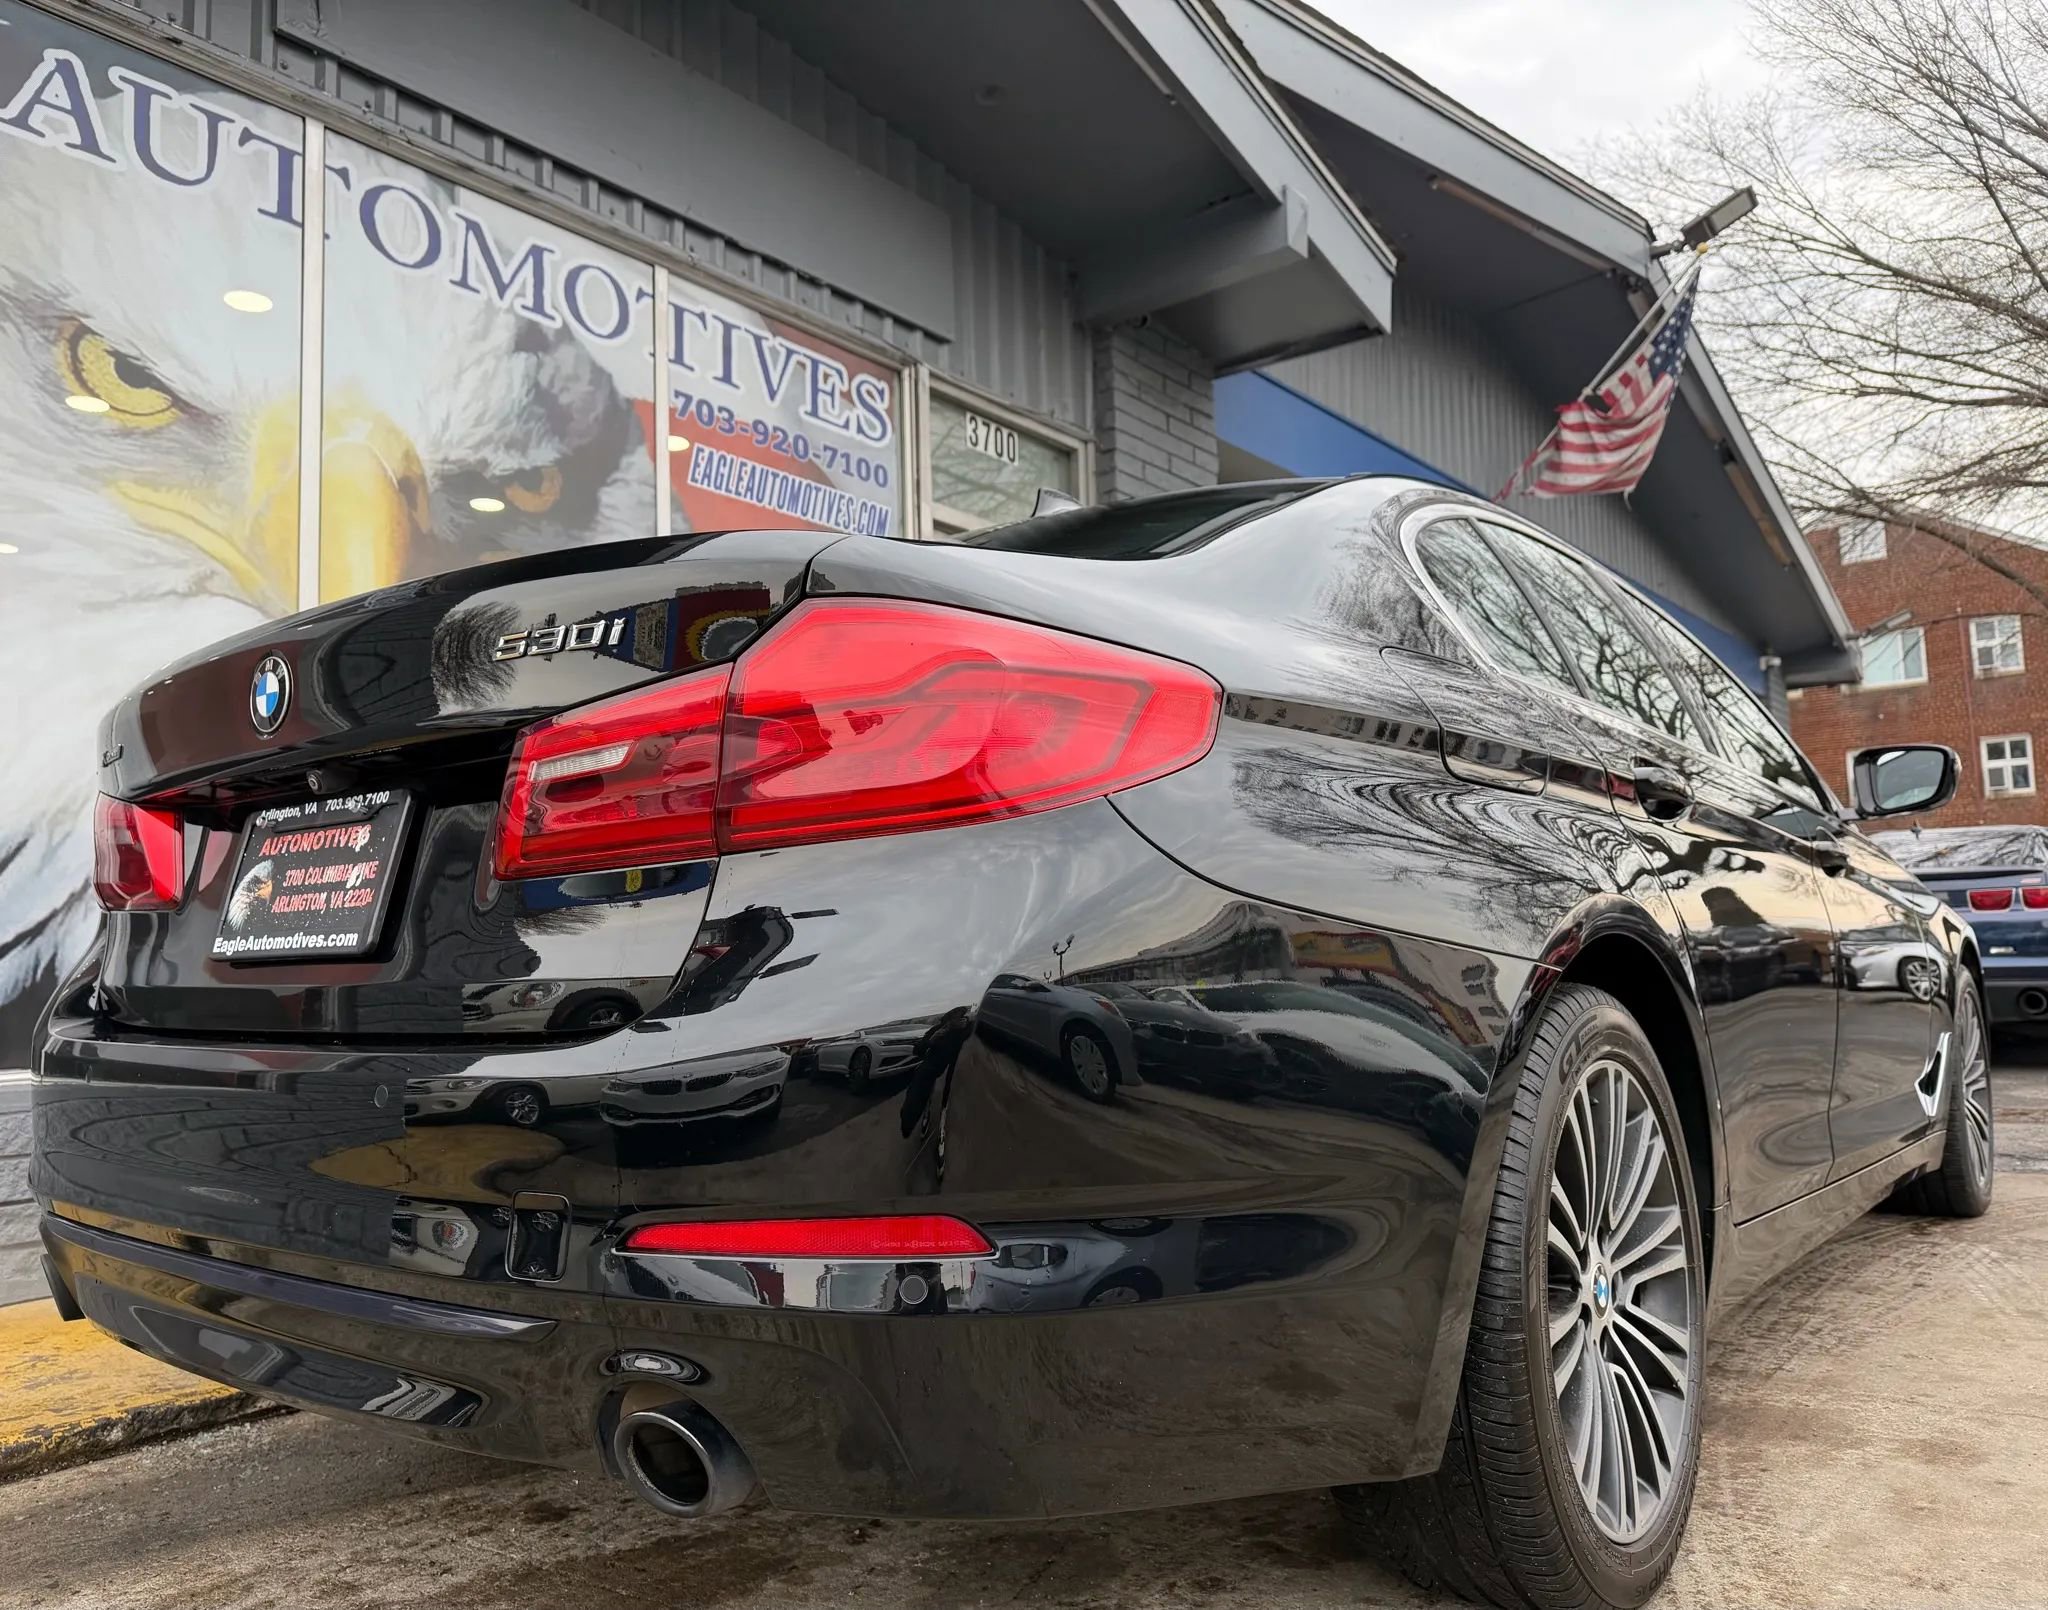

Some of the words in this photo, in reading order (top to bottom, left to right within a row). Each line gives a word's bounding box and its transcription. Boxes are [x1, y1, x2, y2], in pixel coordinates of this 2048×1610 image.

[3, 56, 892, 444] AUTOMOTIVES
[673, 389, 889, 488] 703-920-7100
[969, 415, 1016, 463] 3700
[689, 446, 891, 537] EAGLEAUTOMOTIVES.COM
[492, 616, 628, 662] 530i
[304, 801, 317, 815] VA
[283, 867, 304, 888] 3700
[304, 864, 354, 886] COLUMBIA
[271, 892, 327, 914] ARLINGTON,
[330, 891, 346, 909] VA
[212, 932, 359, 956] EagleAutomotives.com
